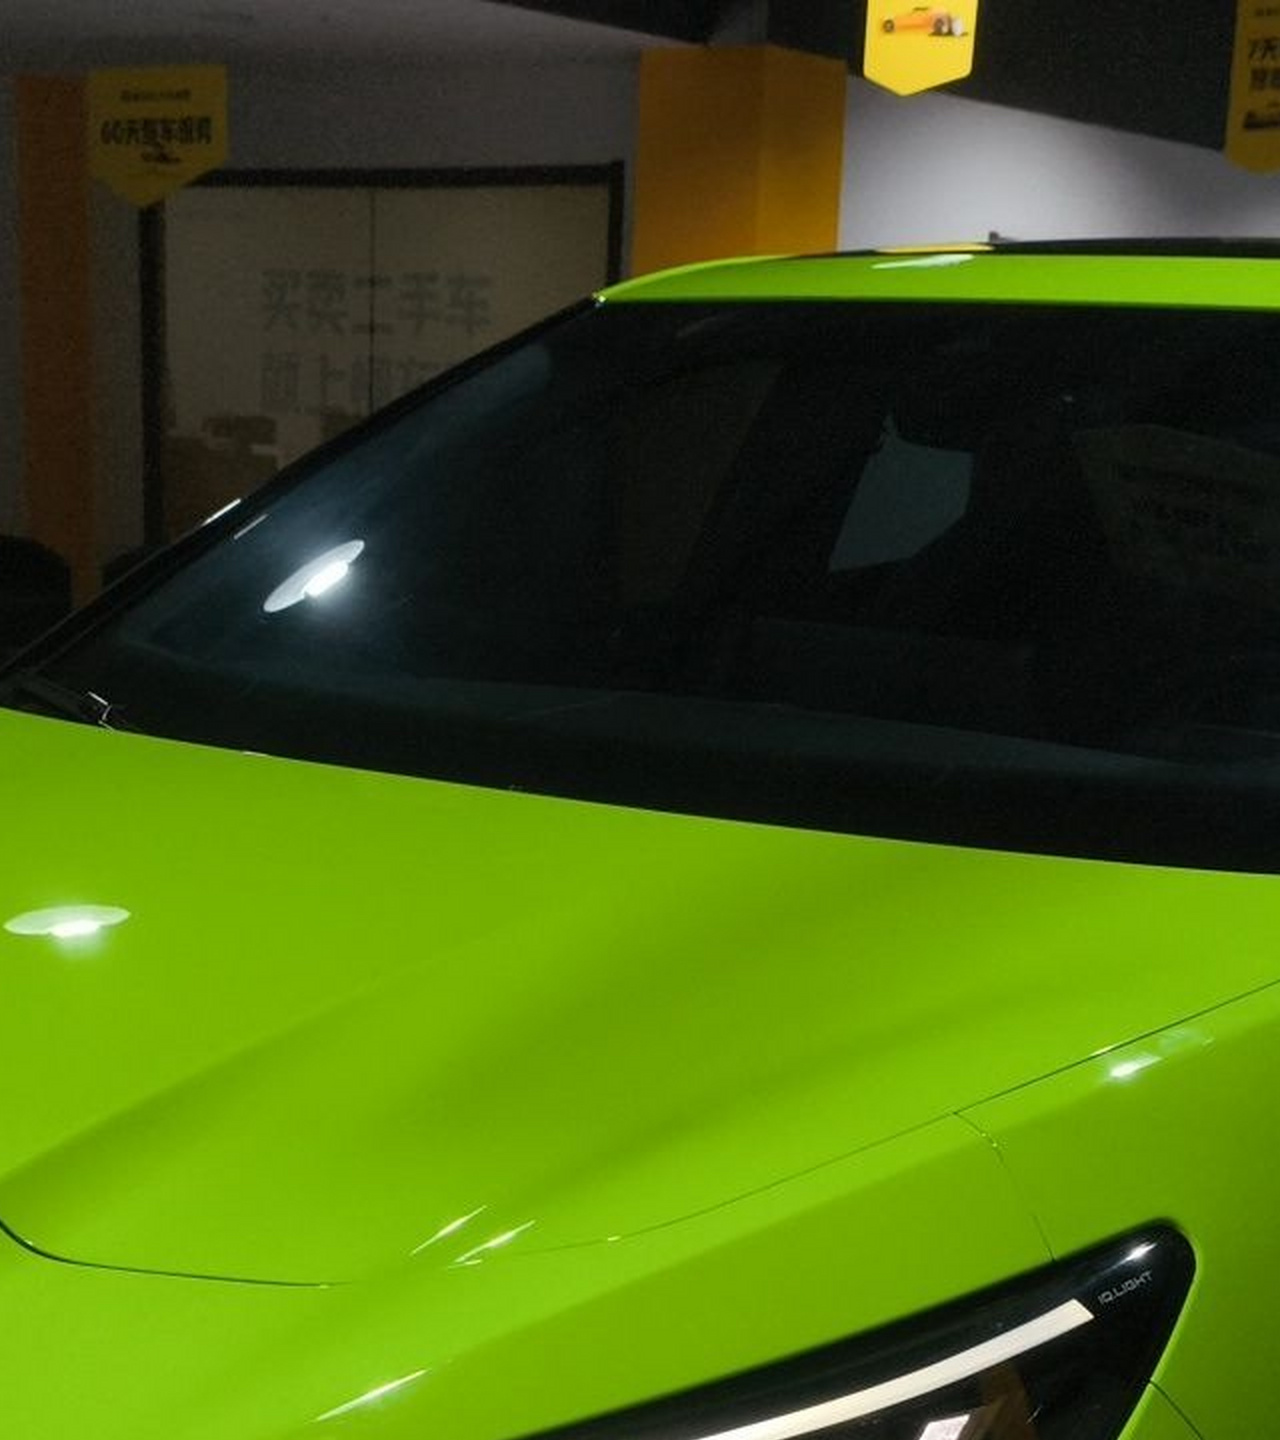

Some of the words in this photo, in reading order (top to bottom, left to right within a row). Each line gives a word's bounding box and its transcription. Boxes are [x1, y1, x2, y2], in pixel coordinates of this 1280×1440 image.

[261, 269, 492, 336] 买卖二手车
